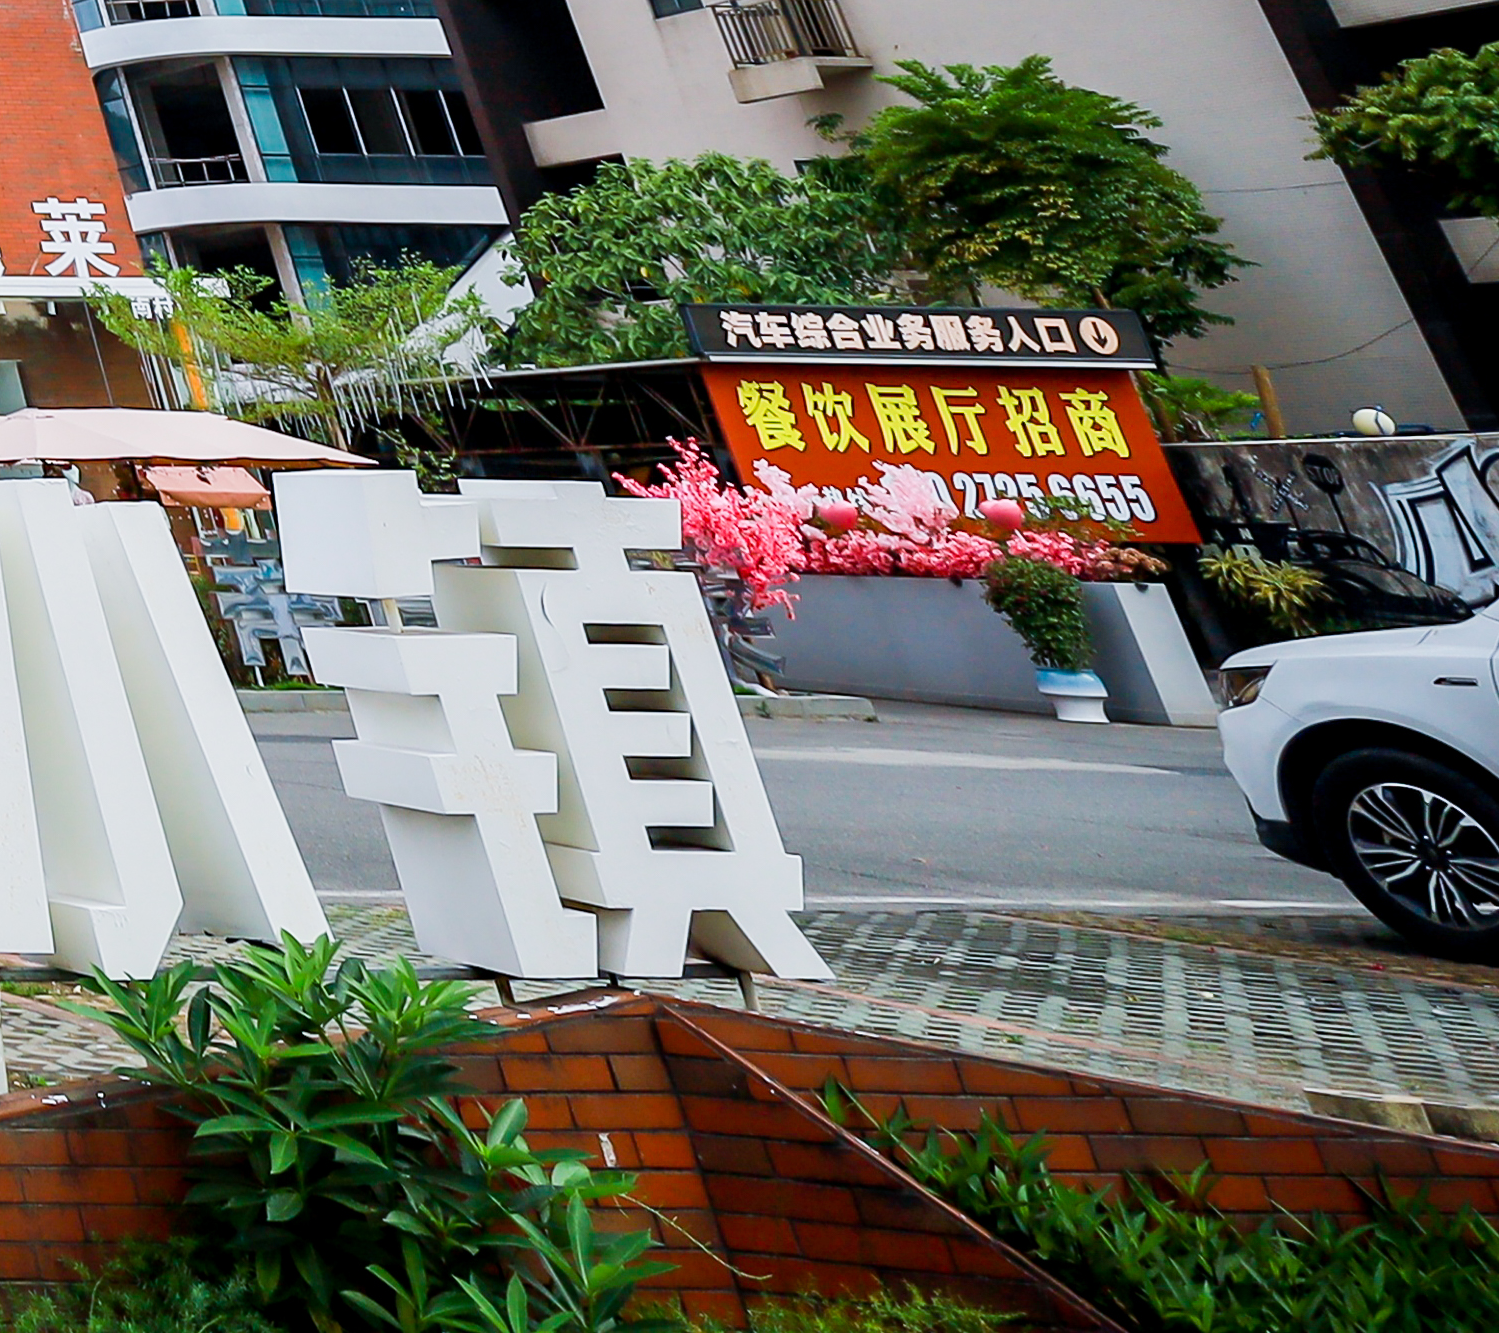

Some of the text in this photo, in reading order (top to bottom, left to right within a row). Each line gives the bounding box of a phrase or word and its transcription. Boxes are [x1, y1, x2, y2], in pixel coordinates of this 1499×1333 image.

[719, 310, 1079, 354] 汽车综合业务服务入口
[736, 379, 1131, 458] 餐饮展厅招商
